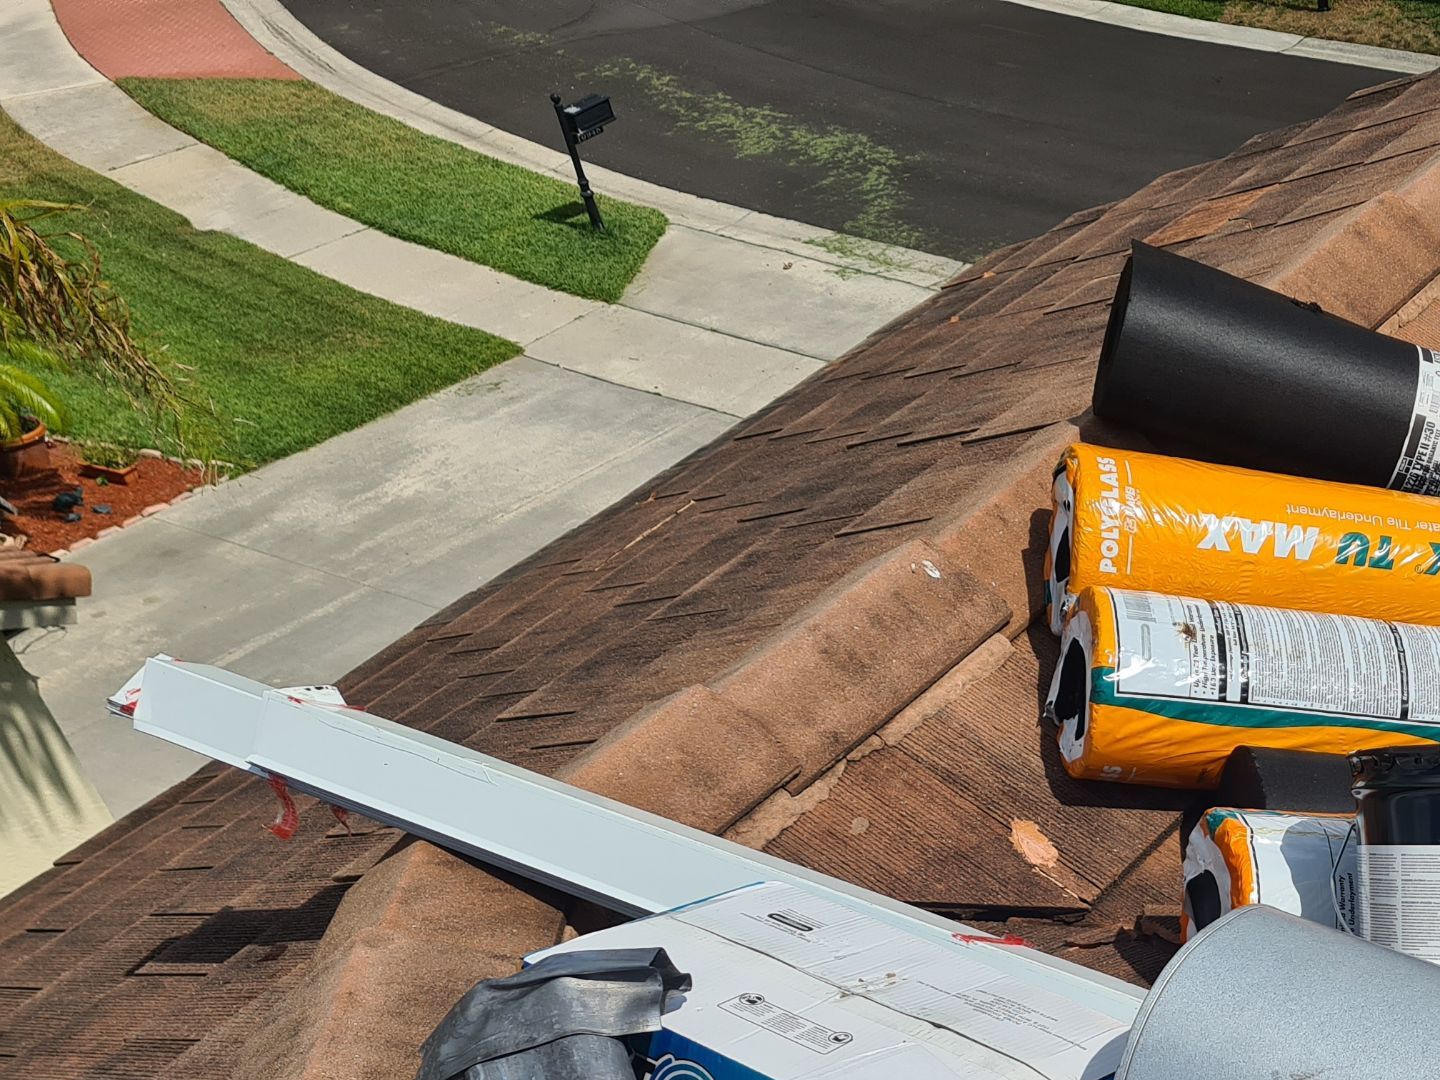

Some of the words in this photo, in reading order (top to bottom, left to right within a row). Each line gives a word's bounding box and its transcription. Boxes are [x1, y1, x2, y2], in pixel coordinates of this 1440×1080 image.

[1412, 451, 1428, 472] TYPE
[1423, 421, 1436, 442] #30
[1097, 456, 1120, 574] POLYGLASS
[1196, 511, 1320, 561] MAX
[1285, 504, 1384, 528] Underlayment
[1386, 517, 1412, 531] Tile
[1335, 531, 1395, 571] TU
[1347, 873, 1355, 925] Underlayment
